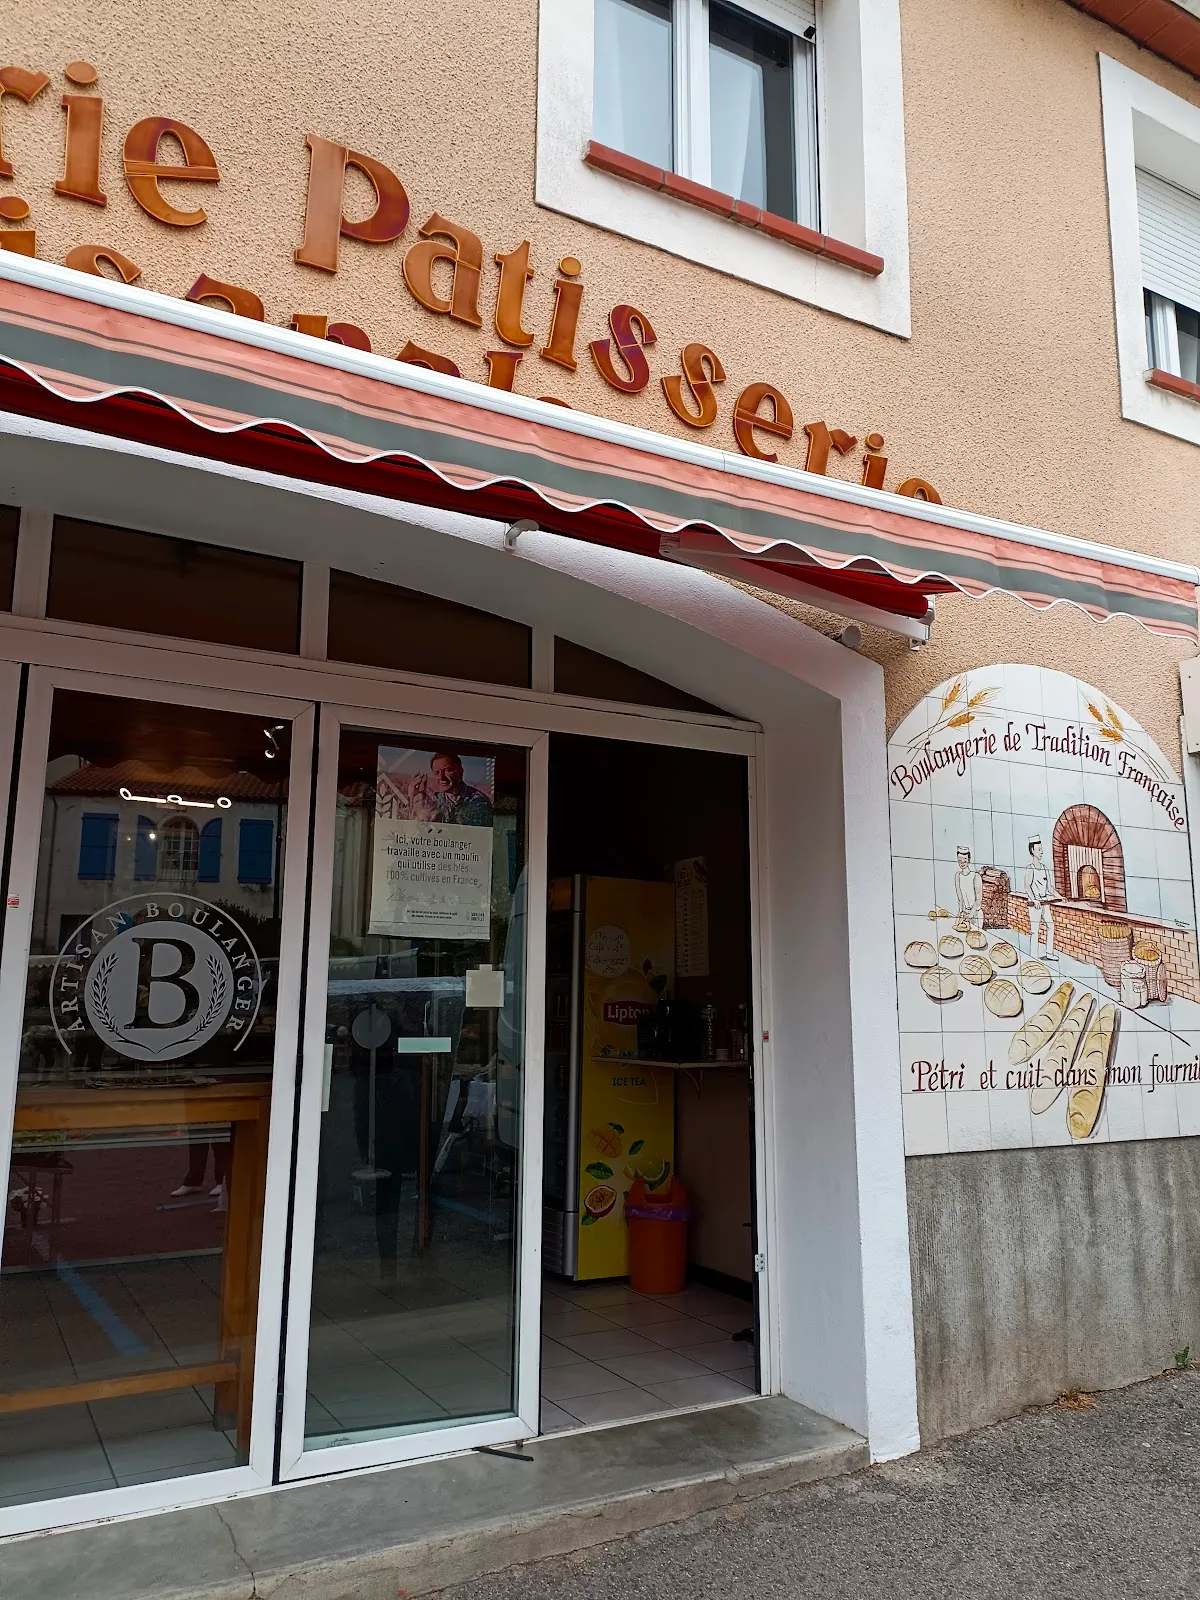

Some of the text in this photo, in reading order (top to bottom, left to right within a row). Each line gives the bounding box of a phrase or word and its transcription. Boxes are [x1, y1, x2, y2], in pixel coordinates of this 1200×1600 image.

[890, 722, 1186, 831] Boulangerie de Tradition Française
[410, 836, 431, 846] votre
[387, 846, 479, 862] travaille avec un moulin
[397, 860, 410, 870] qui
[411, 861, 436, 870] utilise
[437, 863, 452, 872] des
[441, 876, 451, 884] en
[62, 902, 254, 1032] ARTISAN BOULANGER
[124, 937, 200, 1029] B
[911, 1059, 965, 1092] Pétri
[980, 1060, 998, 1089] et
[1006, 1059, 1045, 1089] cuit
[1054, 1057, 1098, 1087] dans
[1105, 1064, 1143, 1085] mon
